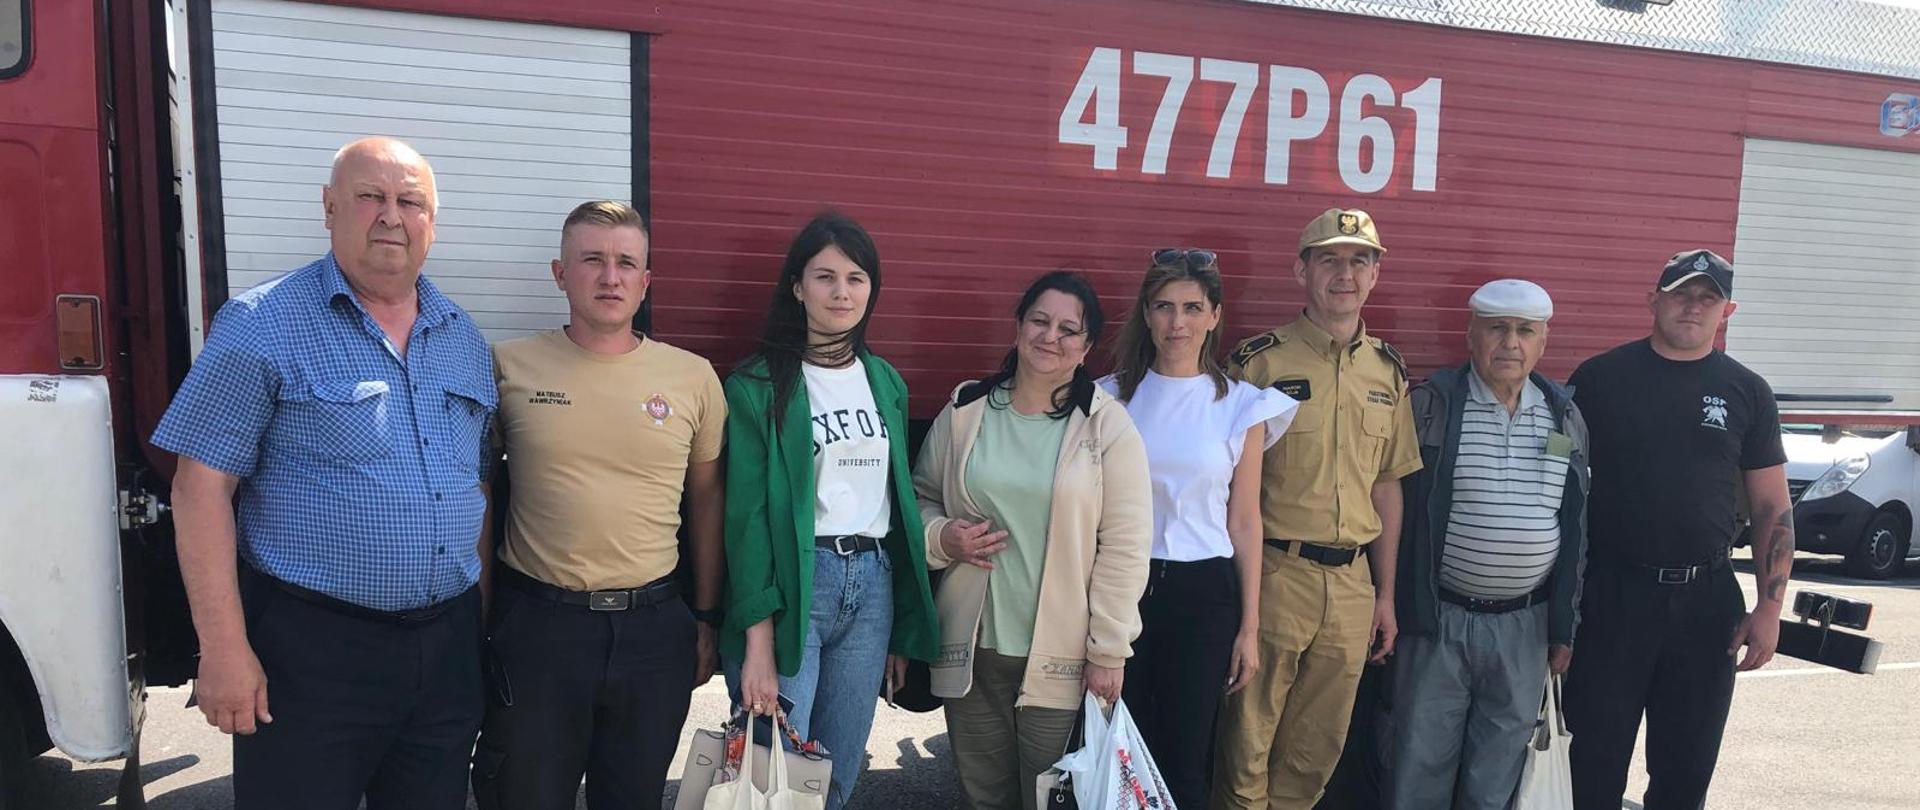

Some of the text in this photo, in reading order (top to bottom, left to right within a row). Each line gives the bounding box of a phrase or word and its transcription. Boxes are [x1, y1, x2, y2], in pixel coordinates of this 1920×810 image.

[1059, 46, 1443, 193] 477P61
[536, 391, 566, 399] MATEUSZ
[1702, 395, 1727, 406] OSP
[838, 458, 881, 467] UNIVERSITY
